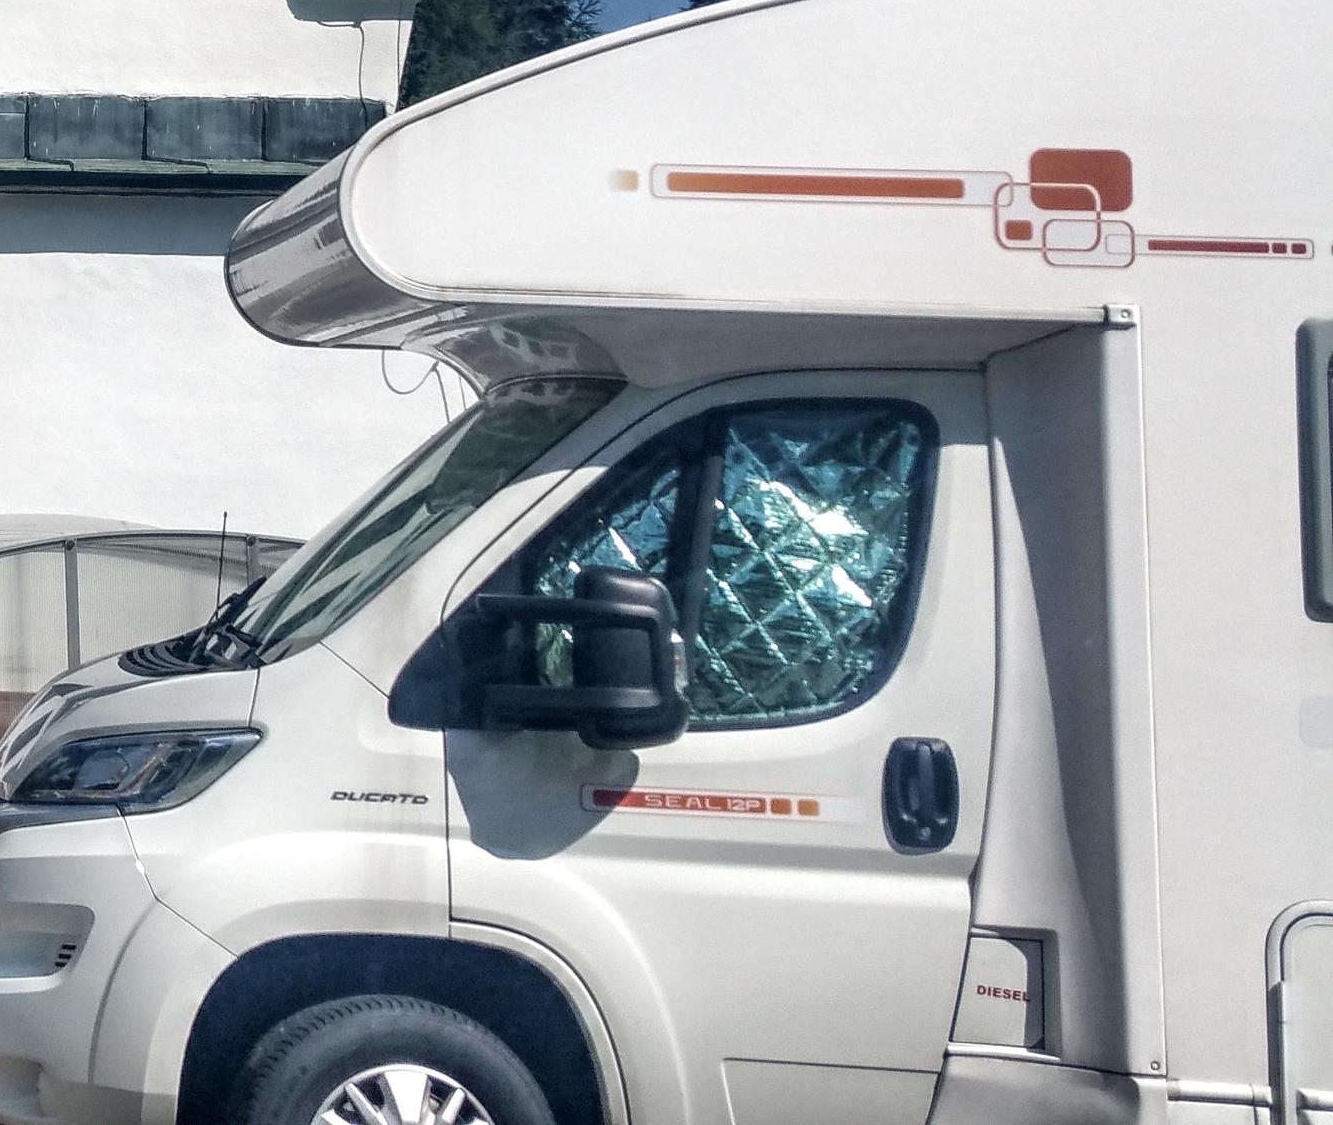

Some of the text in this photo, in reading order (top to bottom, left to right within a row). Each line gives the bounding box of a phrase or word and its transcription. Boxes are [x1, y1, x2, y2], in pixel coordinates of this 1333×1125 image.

[331, 791, 429, 805] DUCATO
[644, 794, 722, 811] SEAL
[976, 984, 1031, 1003] DIESEL
